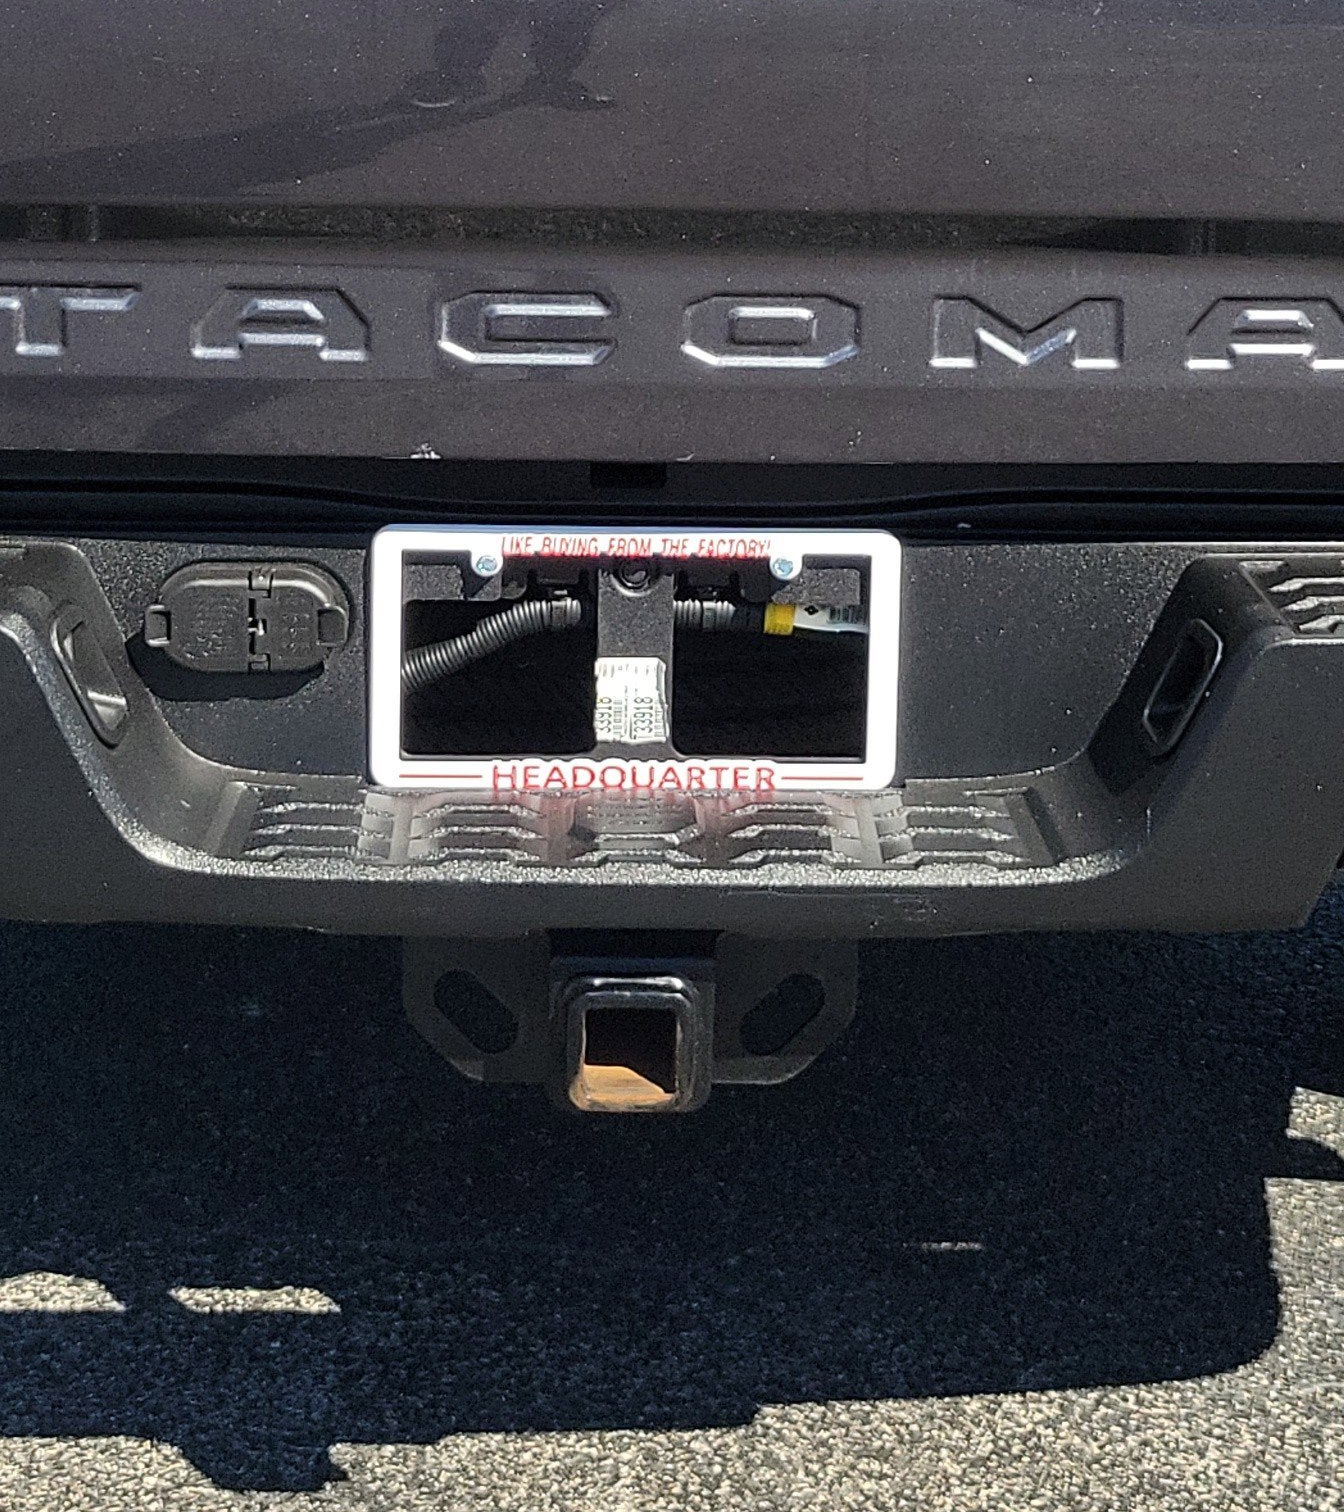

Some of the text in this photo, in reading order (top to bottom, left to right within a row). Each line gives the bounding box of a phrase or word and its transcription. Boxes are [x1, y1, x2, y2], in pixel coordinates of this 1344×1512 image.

[501, 535, 533, 557] LIKE
[606, 536, 653, 558] FROM
[660, 537, 690, 558] THE
[633, 696, 654, 735] 33918
[492, 764, 776, 789] HEADQUARTER
